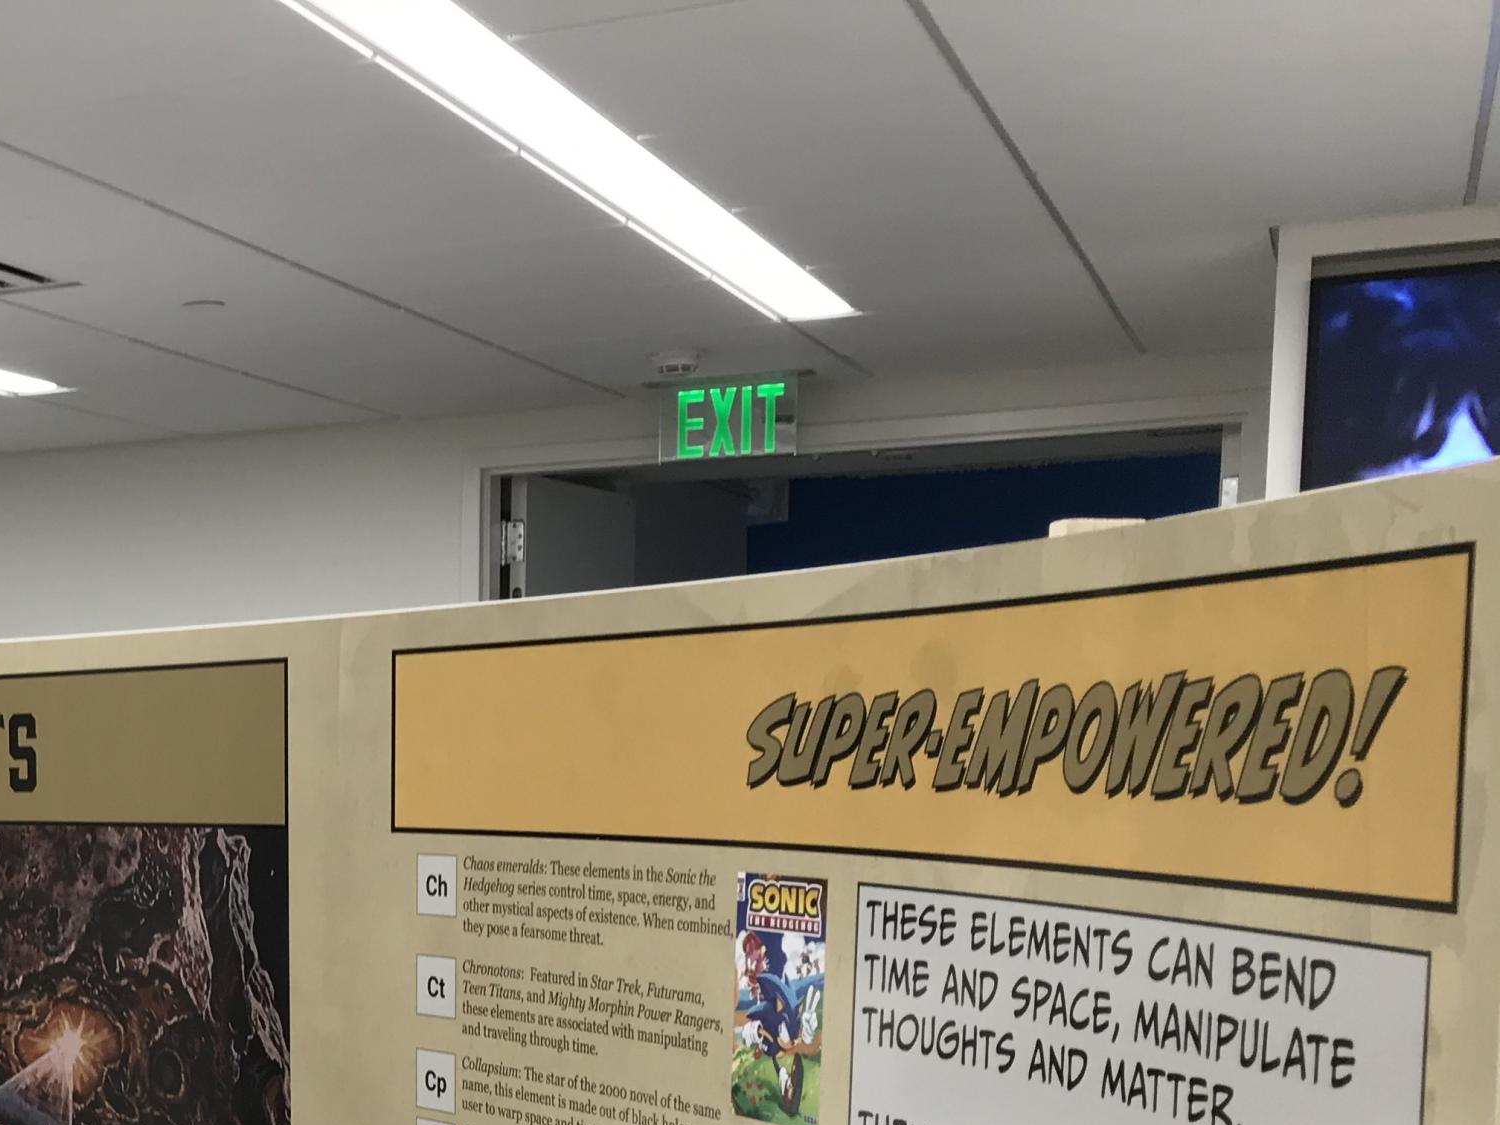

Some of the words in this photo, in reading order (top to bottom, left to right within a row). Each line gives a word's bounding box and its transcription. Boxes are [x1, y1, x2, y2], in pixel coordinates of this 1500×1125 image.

[677, 382, 785, 459] EXIT
[746, 664, 1409, 810] SUPER-EMPOWERED!
[426, 874, 448, 897] Ch
[463, 856, 494, 872] Chaos
[497, 859, 547, 875] emeralds:
[550, 860, 580, 877] These
[583, 861, 630, 879] elements
[633, 864, 643, 881] in
[646, 866, 664, 883] the
[665, 867, 697, 885] Sonic
[699, 869, 716, 886] the
[463, 877, 514, 897] Hedgehog
[517, 881, 546, 897] series
[549, 883, 585, 900] control
[588, 886, 615, 903] time,
[617, 891, 650, 909] space,
[653, 893, 692, 911] energy,
[695, 894, 715, 910] and
[750, 882, 820, 918] SONIC
[749, 915, 765, 926] THE
[770, 917, 819, 933] HEDGEHOG
[866, 901, 956, 946] THESE
[971, 911, 1133, 975] ELEMENTS
[1148, 936, 1214, 989] CAN
[1232, 946, 1336, 1010] BEND
[427, 976, 445, 998] Ct
[463, 959, 524, 979] Chronotons:
[530, 967, 575, 986] Featured
[578, 973, 587, 988] in
[591, 975, 614, 992] Star
[617, 977, 644, 998] Trek,
[647, 982, 705, 1008] Futurama,
[864, 954, 929, 997] TIME
[941, 963, 999, 1011] AND
[1011, 976, 1120, 1043] SPACE,
[1134, 1000, 1356, 1088] MANIPULATE
[862, 1007, 1016, 1073] THOUGHTS
[1028, 1038, 1088, 1091] AND
[424, 1070, 447, 1099] Cp
